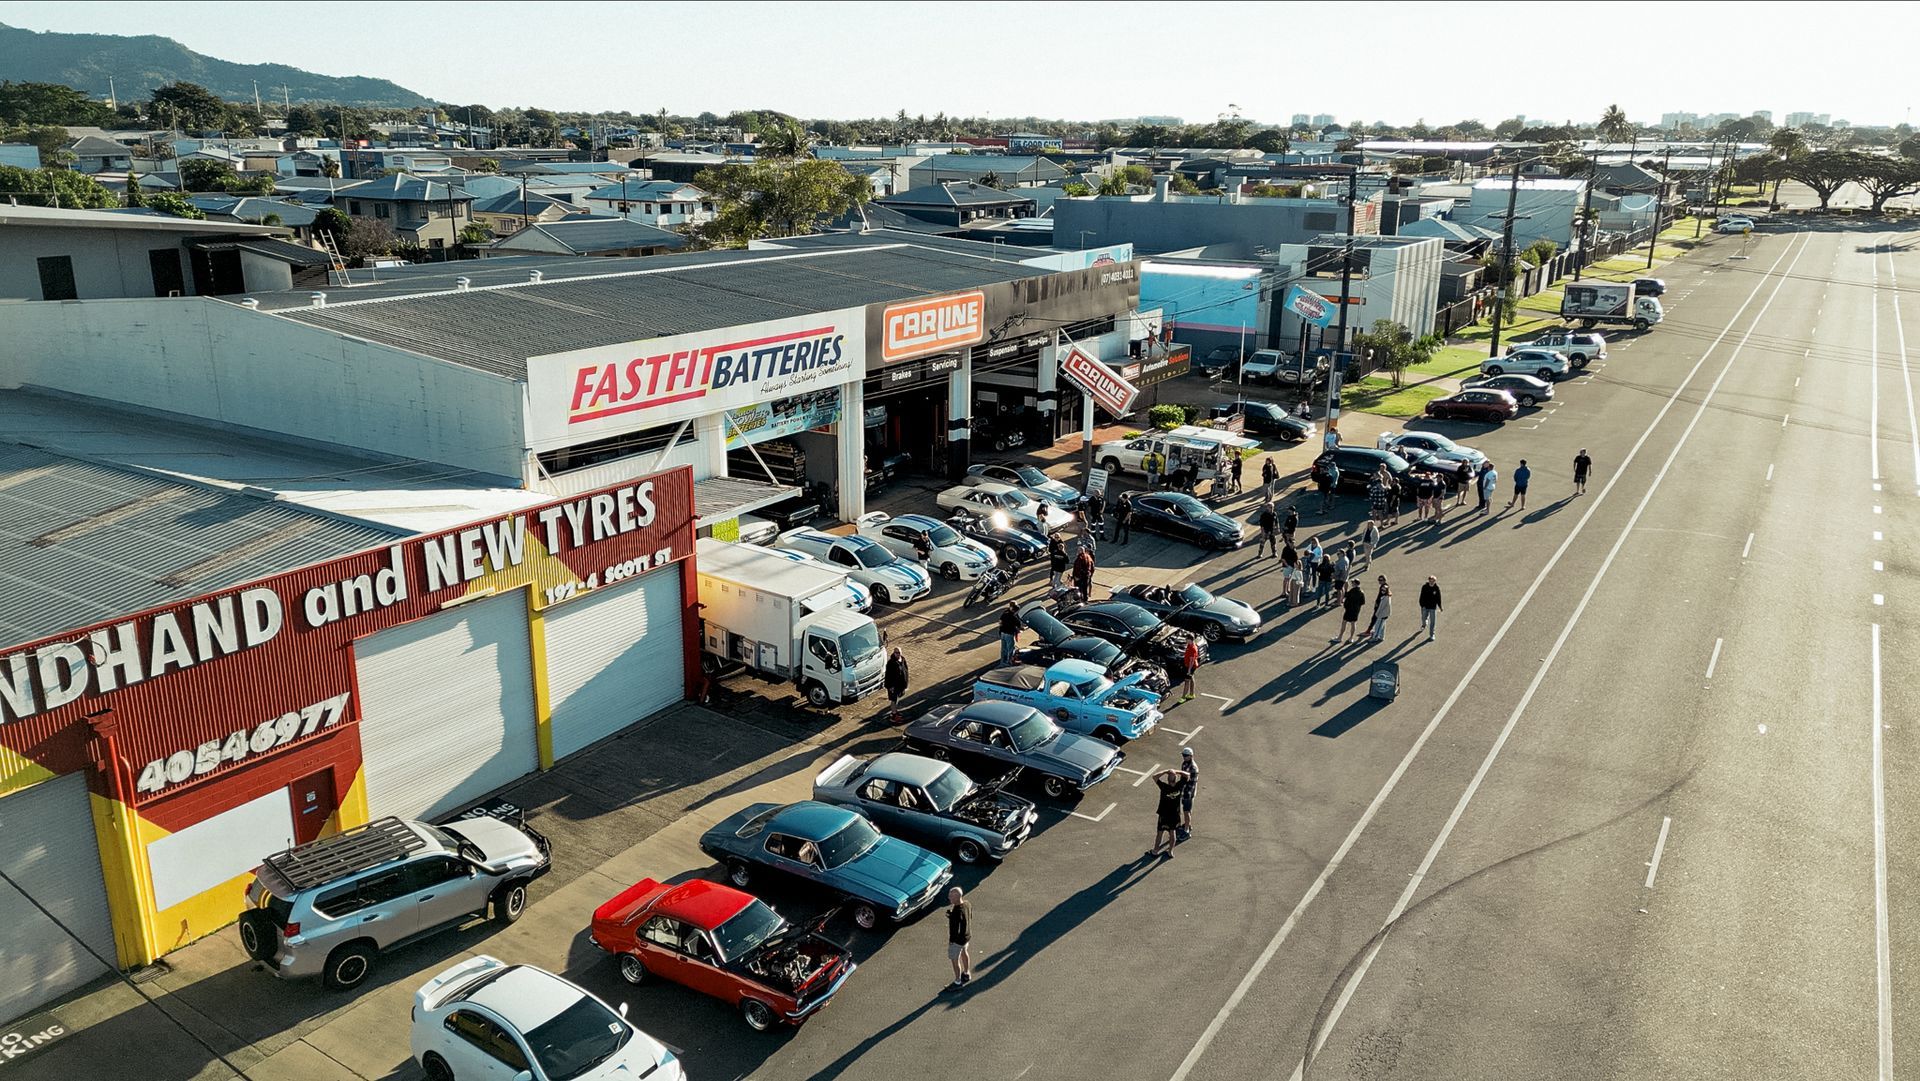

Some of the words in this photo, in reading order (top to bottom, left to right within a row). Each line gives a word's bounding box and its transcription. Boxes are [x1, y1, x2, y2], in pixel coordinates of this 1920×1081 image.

[1022, 139, 1043, 148] GOOD
[888, 301, 978, 350] CARLINE
[989, 344, 1017, 357] Suspension
[570, 348, 715, 411] FASTFIT
[711, 334, 844, 390] BATTERIES
[892, 370, 912, 381] Brakes
[932, 359, 958, 372] Servicing
[1142, 358, 1169, 374] Automotive
[761, 380, 787, 395] Always
[789, 372, 816, 386] Starting
[1063, 373, 1093, 397] Automotive
[1069, 354, 1128, 405] CARLINE
[304, 543, 408, 627] and
[423, 515, 527, 592] NEW
[540, 481, 656, 556] TYRES
[604, 554, 650, 584] SCOTT
[655, 546, 672, 566] ST
[137, 692, 350, 793] 40546977
[461, 807, 487, 820] NO
[0, 1032, 22, 1051] O
